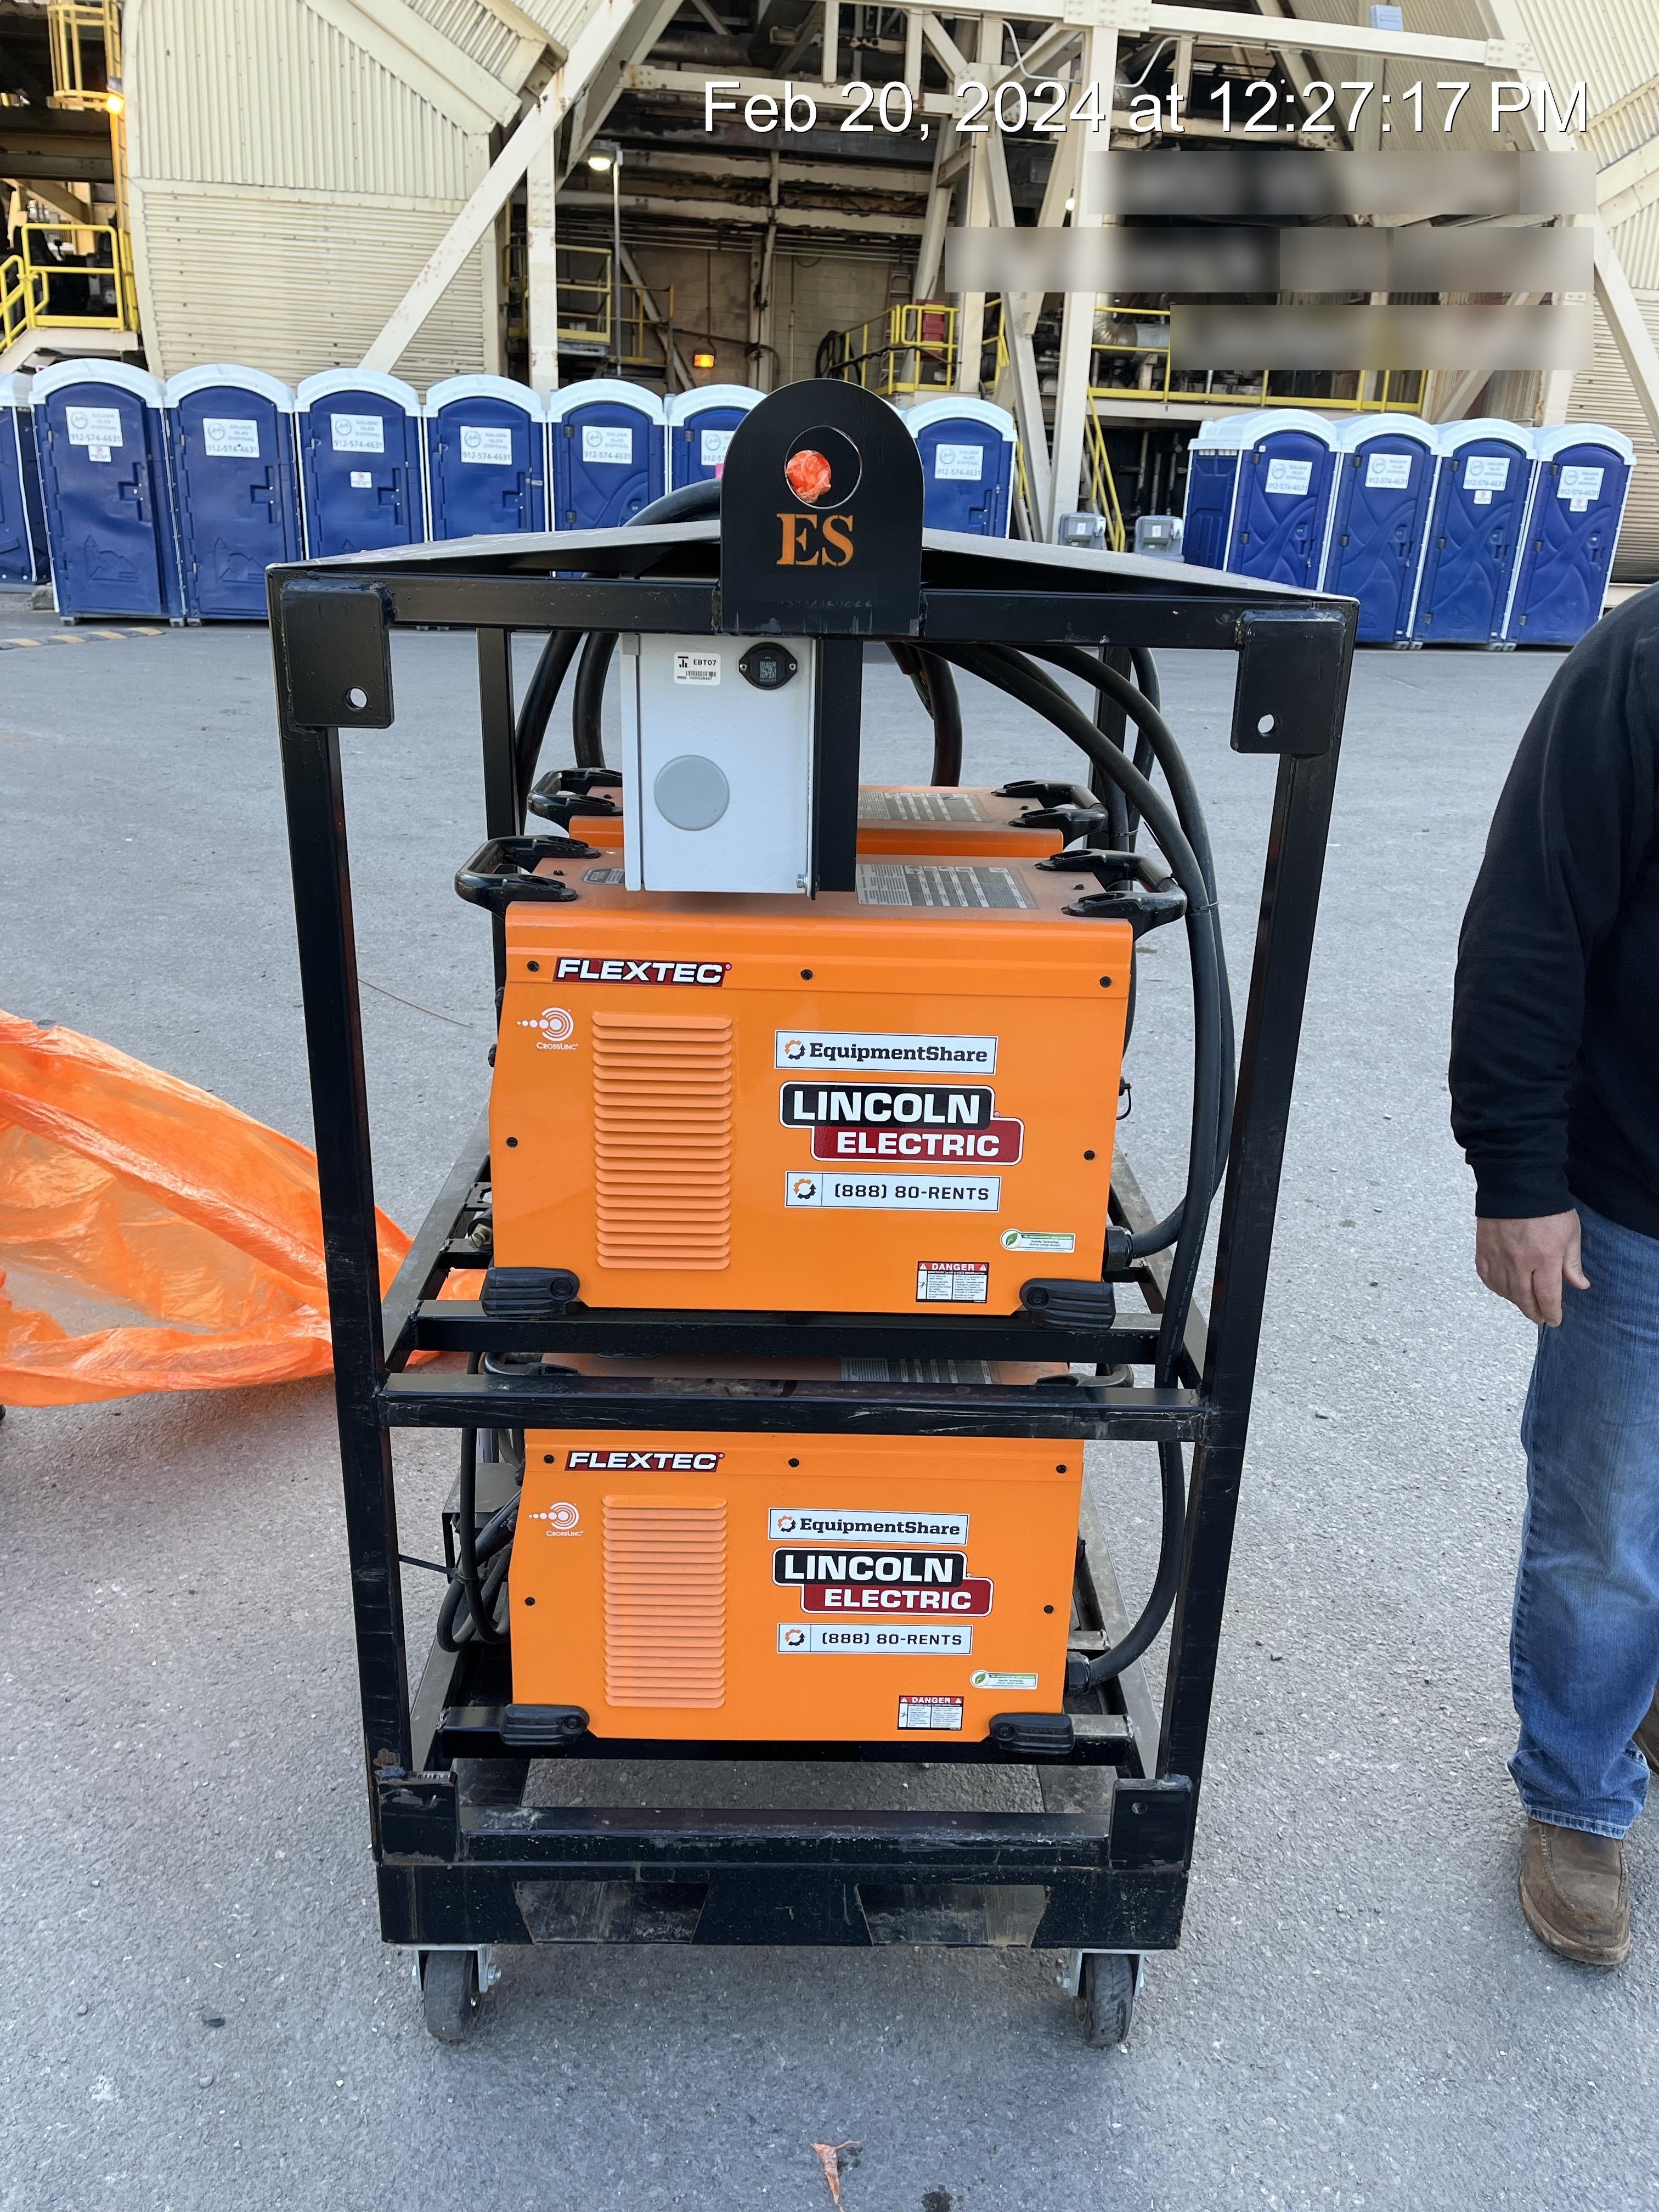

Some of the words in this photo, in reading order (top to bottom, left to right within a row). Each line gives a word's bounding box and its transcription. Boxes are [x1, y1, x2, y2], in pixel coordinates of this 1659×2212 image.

[583, 450, 631, 459] 912-574-4631
[936, 468, 981, 476] 912-574-4631
[776, 513, 854, 567] ES
[557, 959, 723, 984] FLEXTEC
[809, 1042, 988, 1062] EquipmentShare
[793, 1090, 980, 1124] LINCOLN
[837, 1131, 1000, 1157] ELECTRIC
[834, 1183, 887, 1199] (888)
[895, 1185, 989, 1200] 80-RENTS
[932, 1263, 975, 1271] DANGER
[569, 1452, 717, 1470] FLEXTEC
[800, 1518, 960, 1535] EquipmentShare
[785, 1554, 953, 1583] LINCOLN
[825, 1588, 972, 1610] ELECTRIC
[822, 1633, 870, 1645] (888)
[877, 1634, 962, 1645] 80-RENTS
